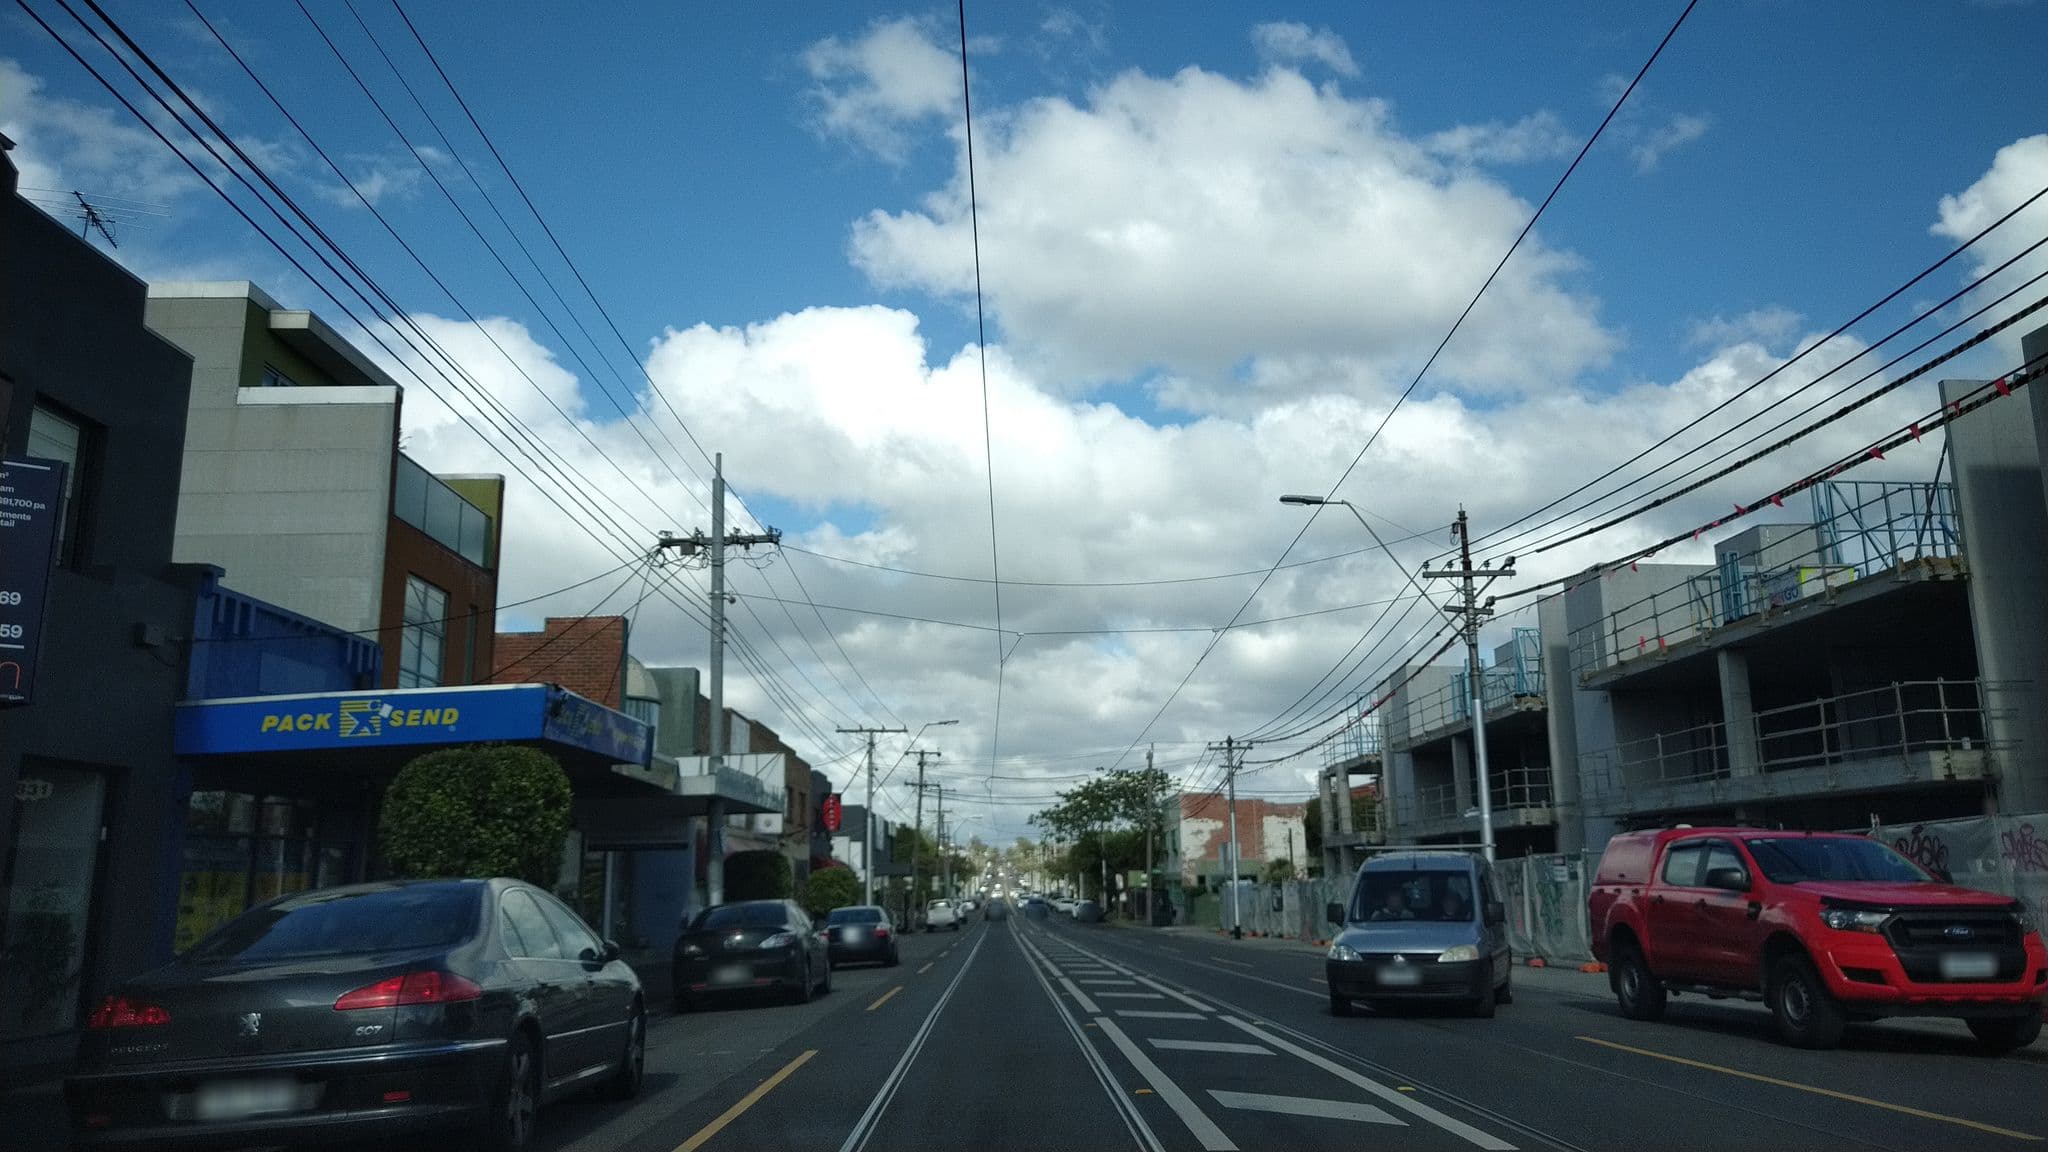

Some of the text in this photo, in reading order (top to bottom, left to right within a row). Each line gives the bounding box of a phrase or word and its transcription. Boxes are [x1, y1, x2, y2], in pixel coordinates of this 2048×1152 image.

[33, 502, 46, 510] pa
[0, 591, 22, 605] 69
[0, 624, 23, 638] 59
[260, 708, 460, 733] PACK SEND
